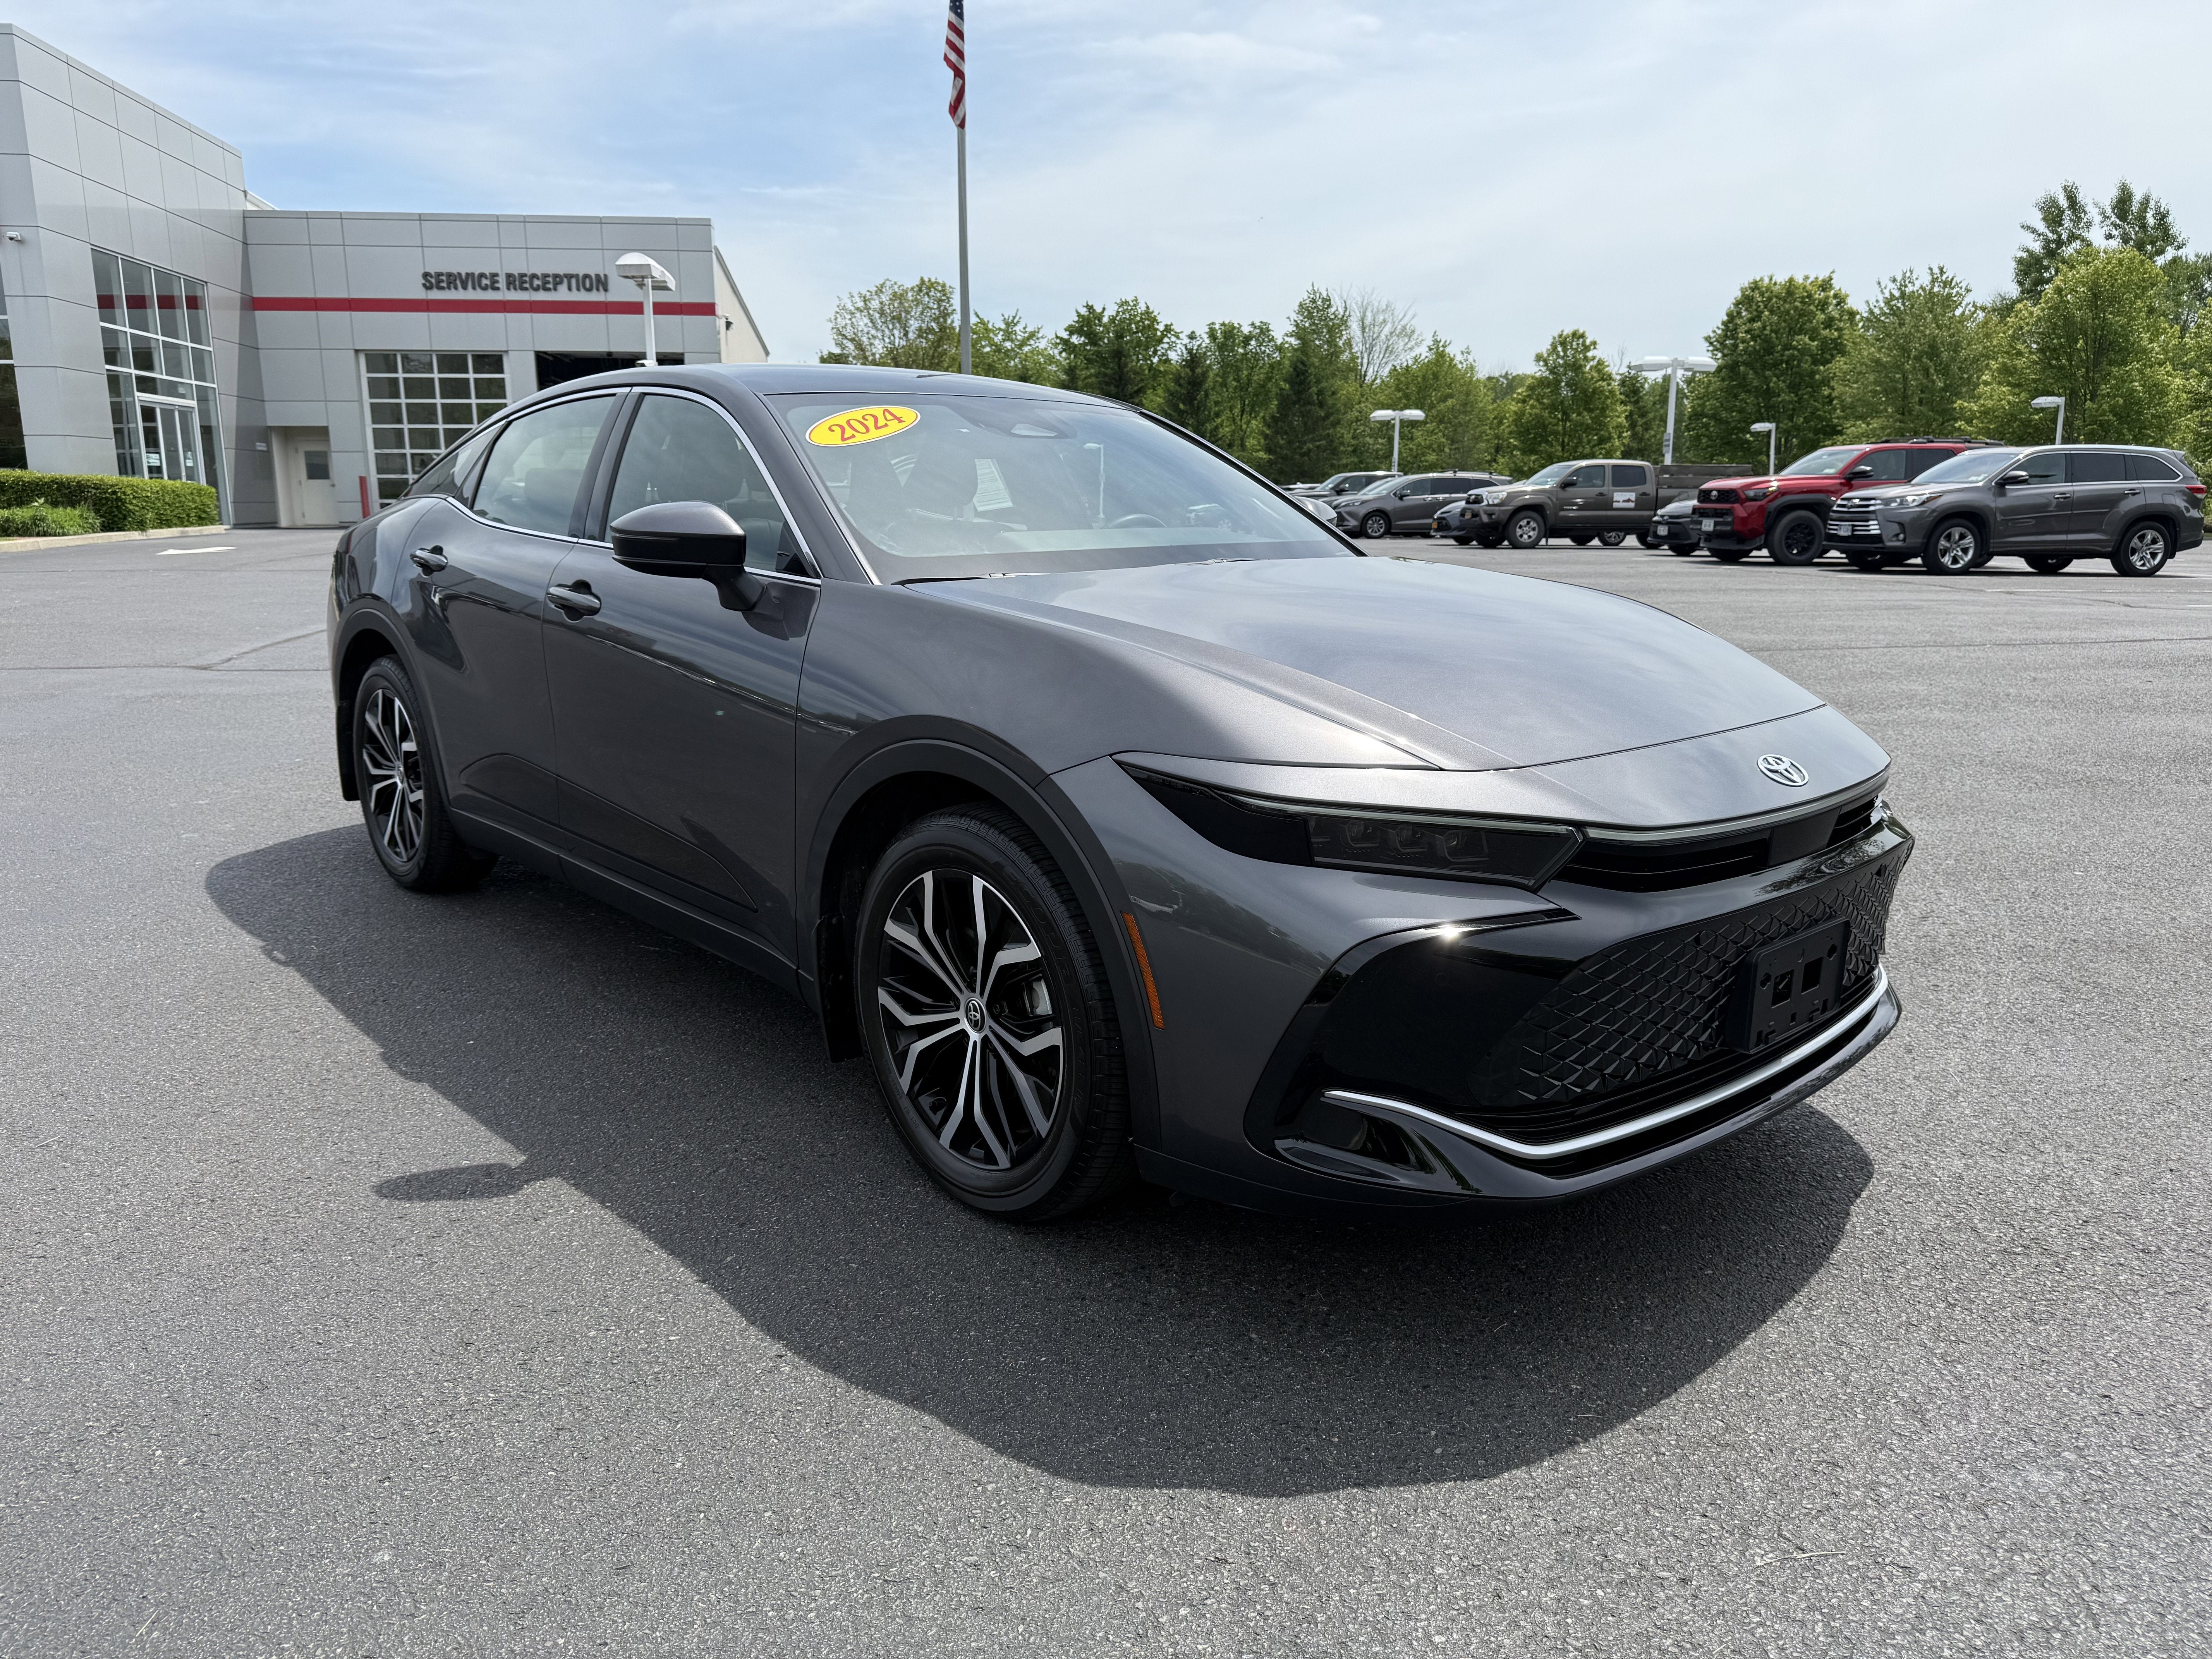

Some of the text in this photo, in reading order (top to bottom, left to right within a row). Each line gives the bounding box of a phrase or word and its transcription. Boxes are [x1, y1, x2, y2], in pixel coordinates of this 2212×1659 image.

[422, 272, 609, 292] SERVICE RECEPTION
[828, 409, 905, 441] 2024
[1164, 780, 1198, 792] CROWN
